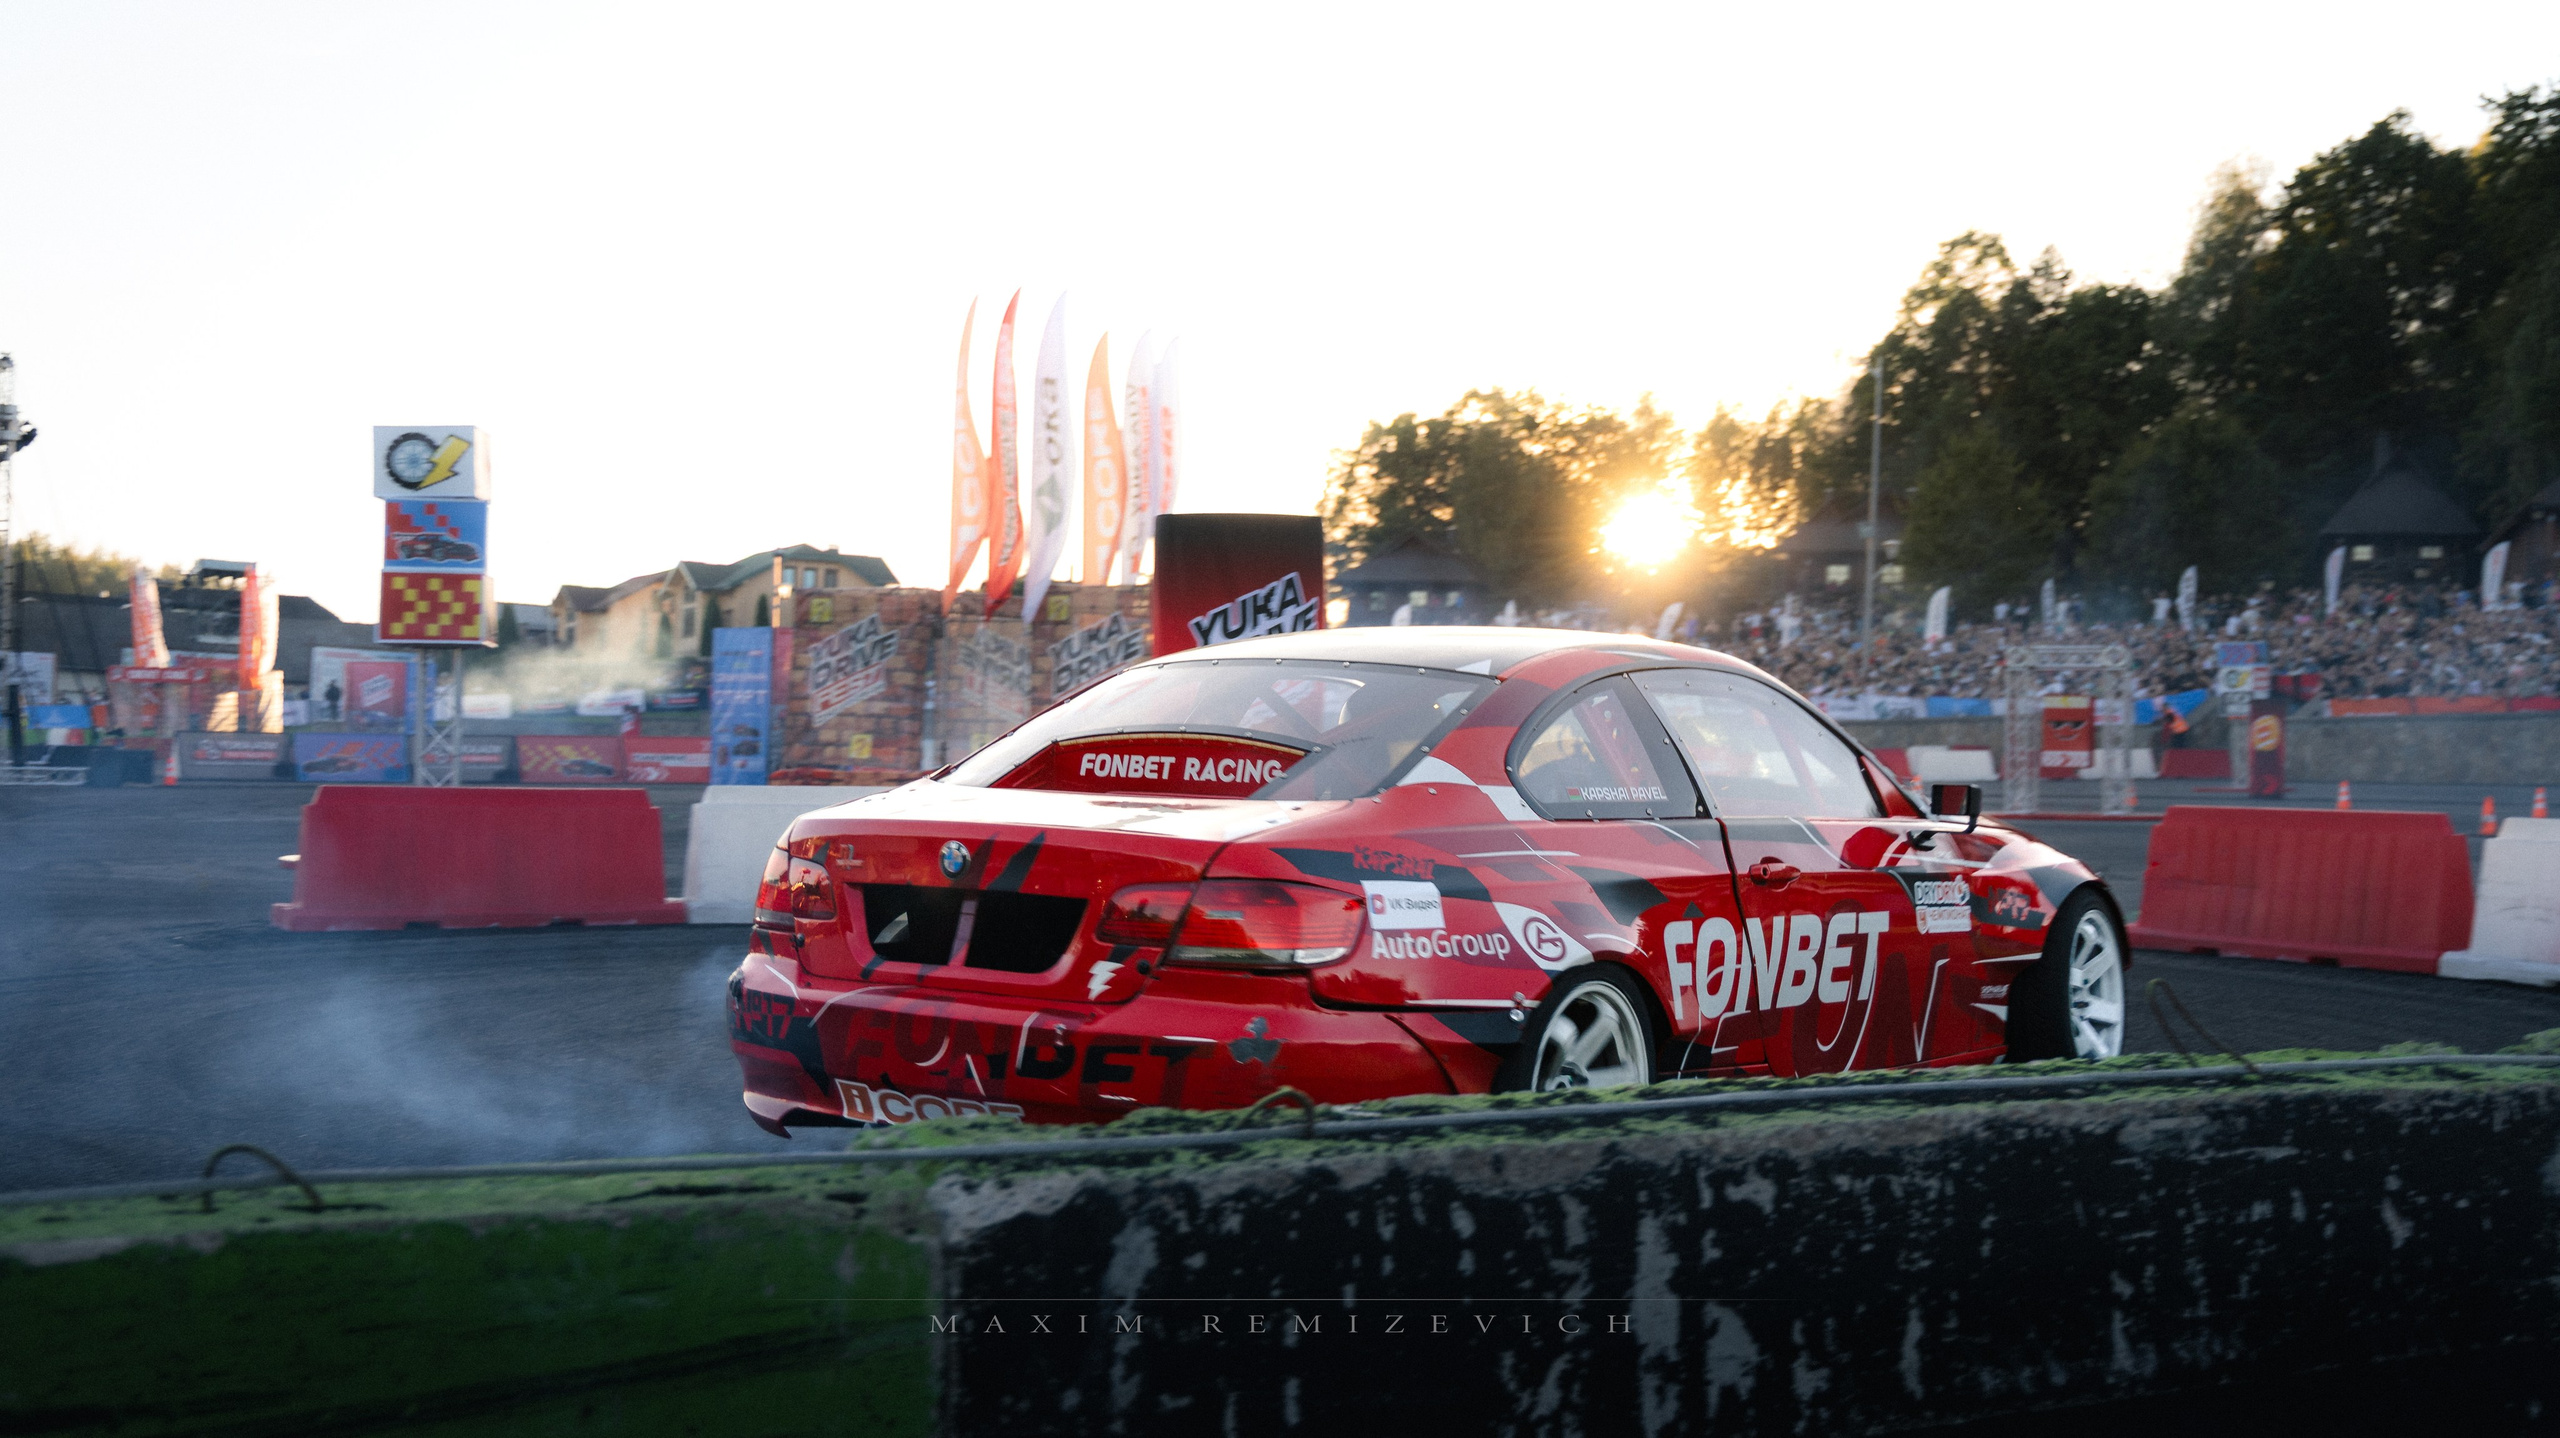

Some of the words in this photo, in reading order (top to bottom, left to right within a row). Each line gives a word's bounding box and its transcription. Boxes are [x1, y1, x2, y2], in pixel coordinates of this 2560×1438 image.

[1194, 577, 1301, 645] YUKA
[1080, 753, 1176, 780] FONBET
[1184, 757, 1284, 784] RACING
[1580, 786, 1630, 800] KAPSHAI
[1630, 786, 1668, 800] PAVEL
[1372, 929, 1511, 961] AutoGroup
[1663, 911, 1890, 1020] FONBET
